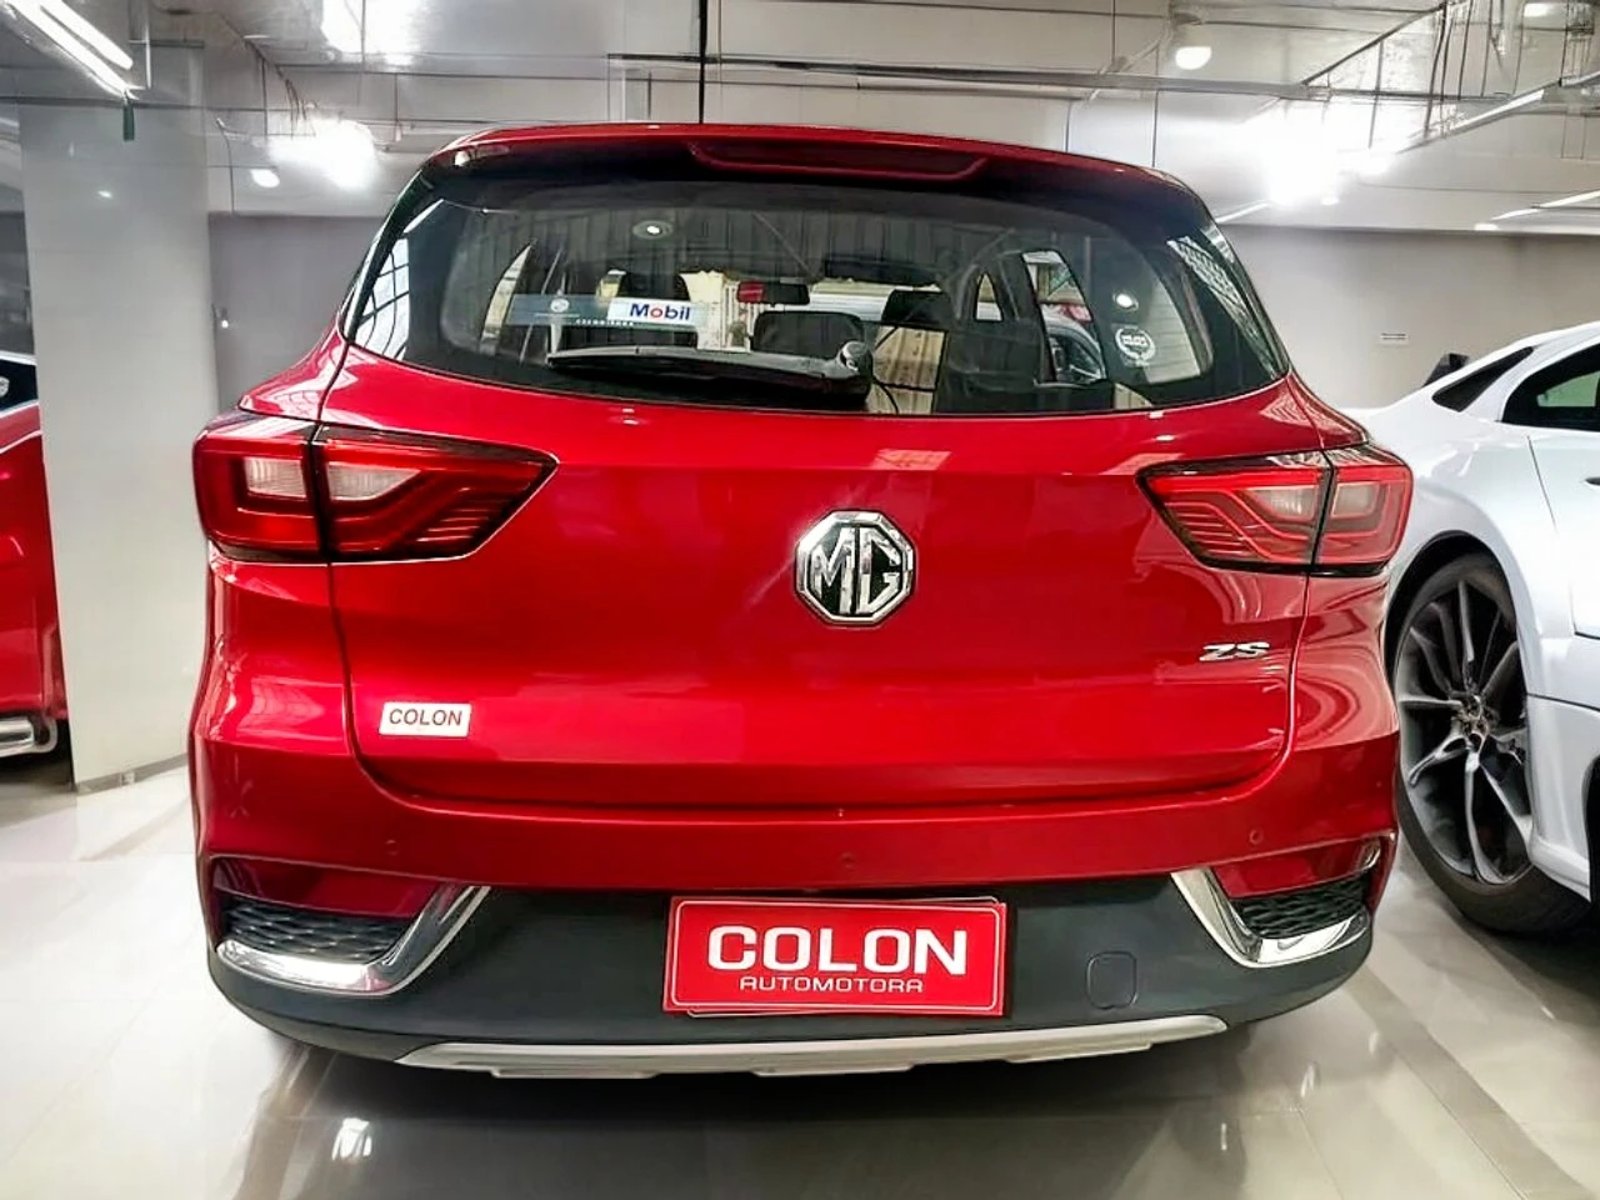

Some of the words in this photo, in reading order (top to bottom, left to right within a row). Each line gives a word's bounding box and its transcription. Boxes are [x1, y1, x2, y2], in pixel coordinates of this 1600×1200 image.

[630, 303, 691, 320] Mobil
[810, 527, 901, 614] MG
[1199, 641, 1270, 661] ZS
[389, 708, 462, 726] COLON
[708, 925, 968, 975] COLON
[740, 976, 923, 993] AUTOMOTORA
